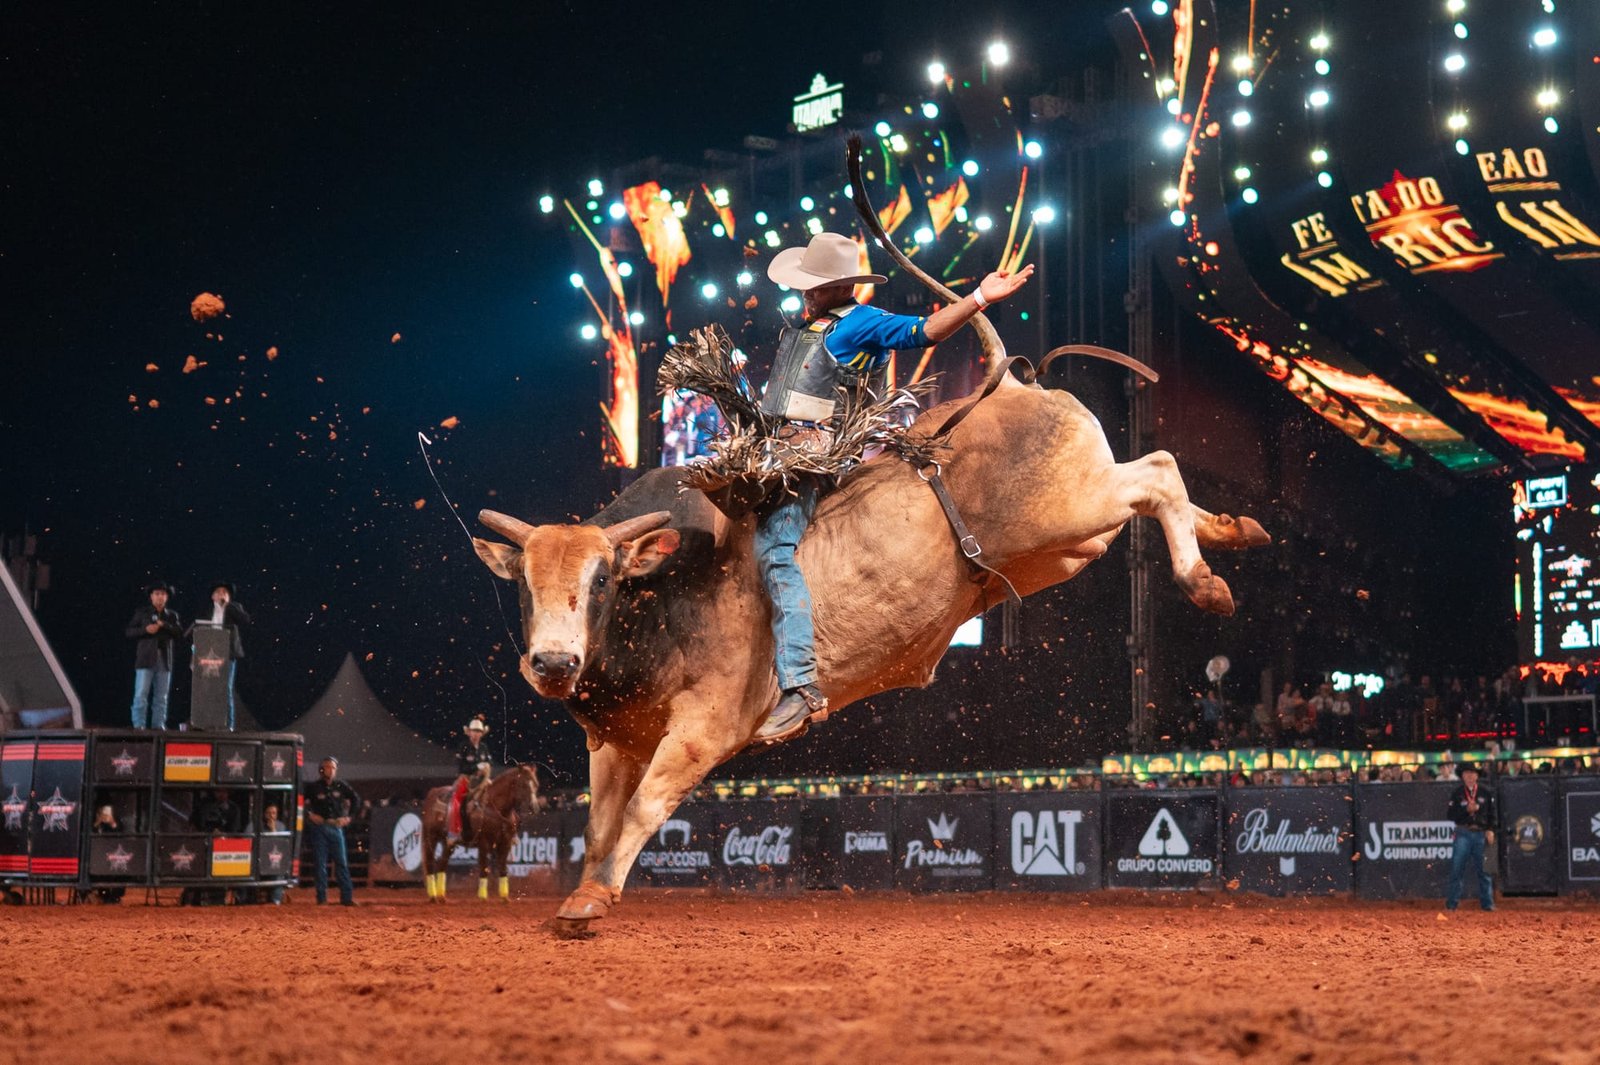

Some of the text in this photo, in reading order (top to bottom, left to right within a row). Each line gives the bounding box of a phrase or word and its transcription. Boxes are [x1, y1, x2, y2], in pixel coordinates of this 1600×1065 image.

[1395, 176, 1444, 210] DO
[1291, 212, 1333, 249] FE
[904, 840, 983, 869] Premium
[1011, 810, 1082, 875] CAT
[1117, 858, 1212, 872] GRUPO CONVERD
